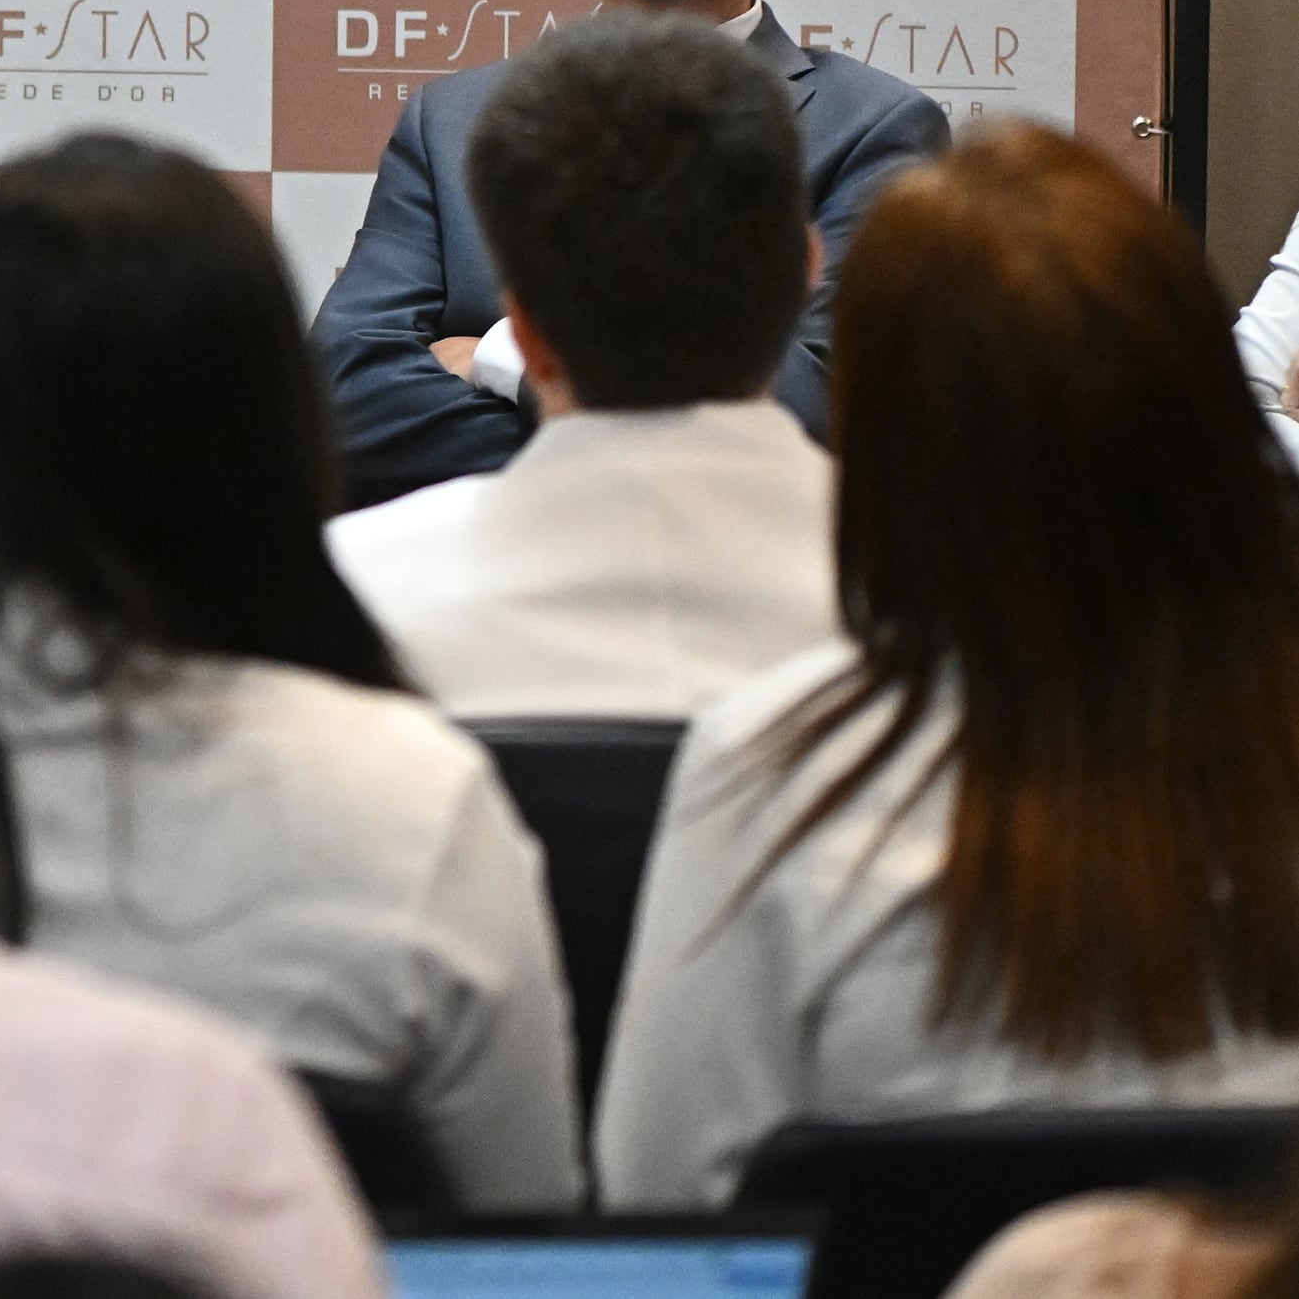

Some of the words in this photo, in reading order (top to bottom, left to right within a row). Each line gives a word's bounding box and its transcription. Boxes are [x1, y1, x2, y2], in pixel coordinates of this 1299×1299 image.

[46, 0, 209, 61] STAR
[337, 9, 428, 58] DF
[865, 13, 1019, 75] STAR
[98, 85, 175, 102] D'OR
